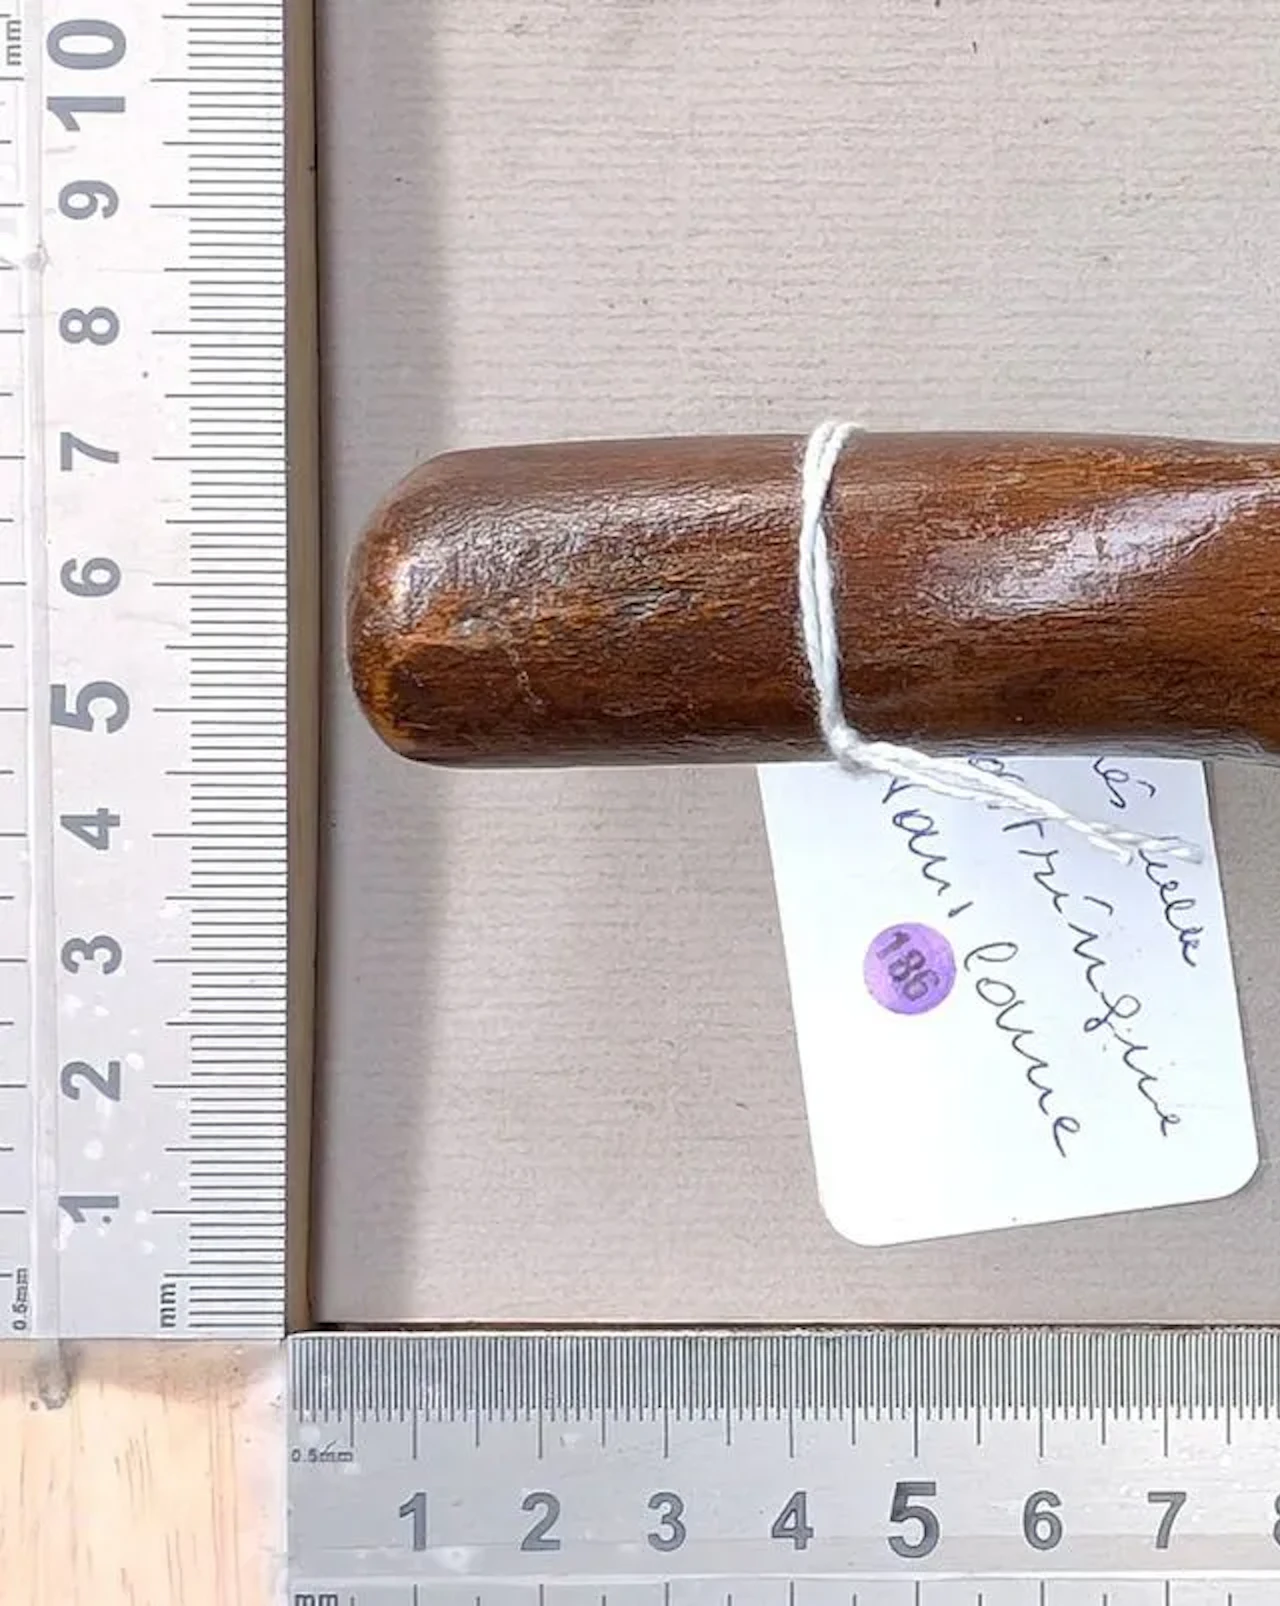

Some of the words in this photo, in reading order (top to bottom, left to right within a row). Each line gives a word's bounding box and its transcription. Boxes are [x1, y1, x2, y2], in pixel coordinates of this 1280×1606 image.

[46, 19, 126, 132] 10
[58, 180, 119, 220] 9
[59, 306, 120, 346] 8
[60, 432, 120, 472] 7
[60, 557, 121, 597] 6
[49, 681, 130, 733] 5
[60, 808, 120, 850] 4
[61, 935, 122, 975] 3
[874, 930, 941, 1003] 186
[60, 1061, 121, 1102] 2
[58, 1195, 120, 1223] 1
[160, 1282, 177, 1328] mm
[399, 1492, 426, 1552] 1
[520, 1492, 561, 1552] 2
[648, 1492, 686, 1552] 3
[771, 1491, 814, 1551] 4
[888, 1481, 939, 1560] 5
[1023, 1491, 1063, 1551] 6
[1147, 1490, 1187, 1550] 7
